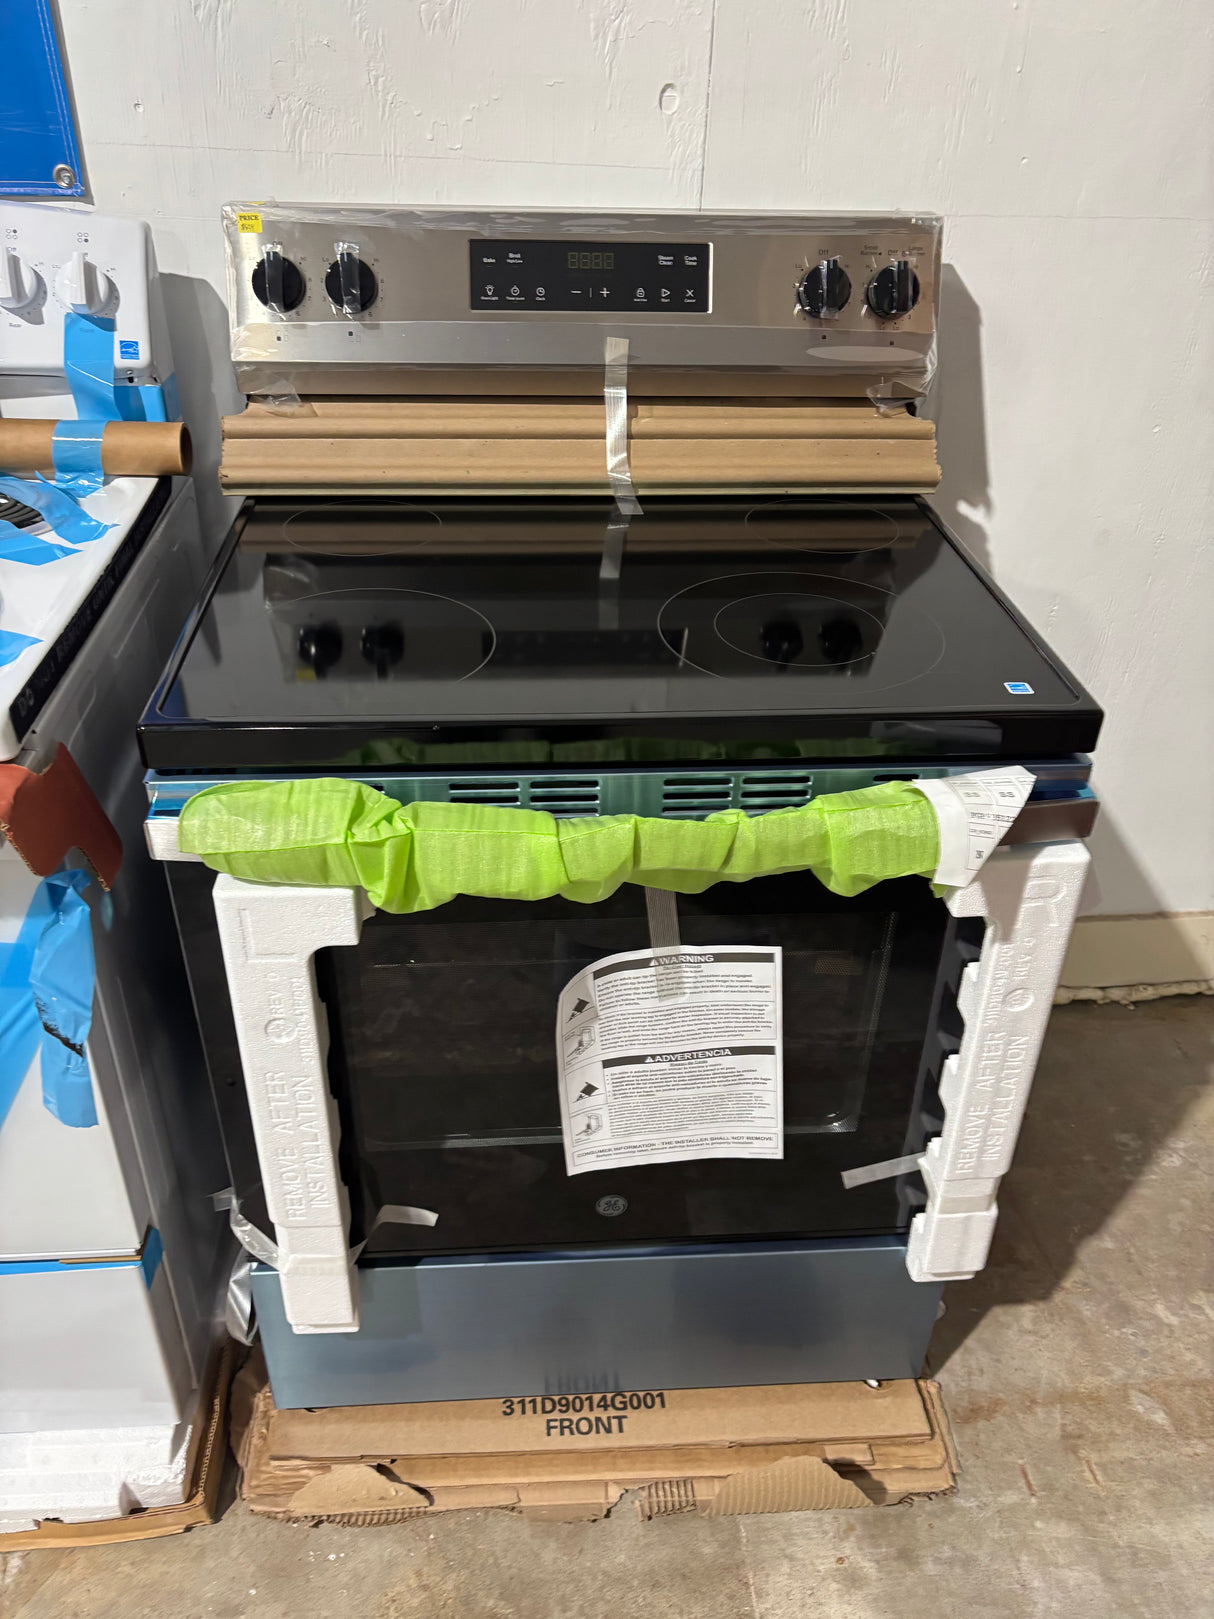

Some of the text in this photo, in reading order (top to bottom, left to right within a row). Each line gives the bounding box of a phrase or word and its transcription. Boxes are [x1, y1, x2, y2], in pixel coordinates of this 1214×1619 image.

[658, 953, 715, 965] WARNING
[655, 1048, 732, 1063] ADVERTENCIA
[955, 1032, 1008, 1175] REMOVE AFTER
[981, 1035, 1030, 1161] INSTALLATION
[264, 1071, 308, 1221] REMOVE AFTER
[293, 1075, 331, 1209] INSTALLATION
[613, 1142, 657, 1152] INFORMATION
[674, 1137, 709, 1145] INSTALLER
[502, 1392, 666, 1416] 311D9014G001
[546, 1415, 629, 1437] FRONT
